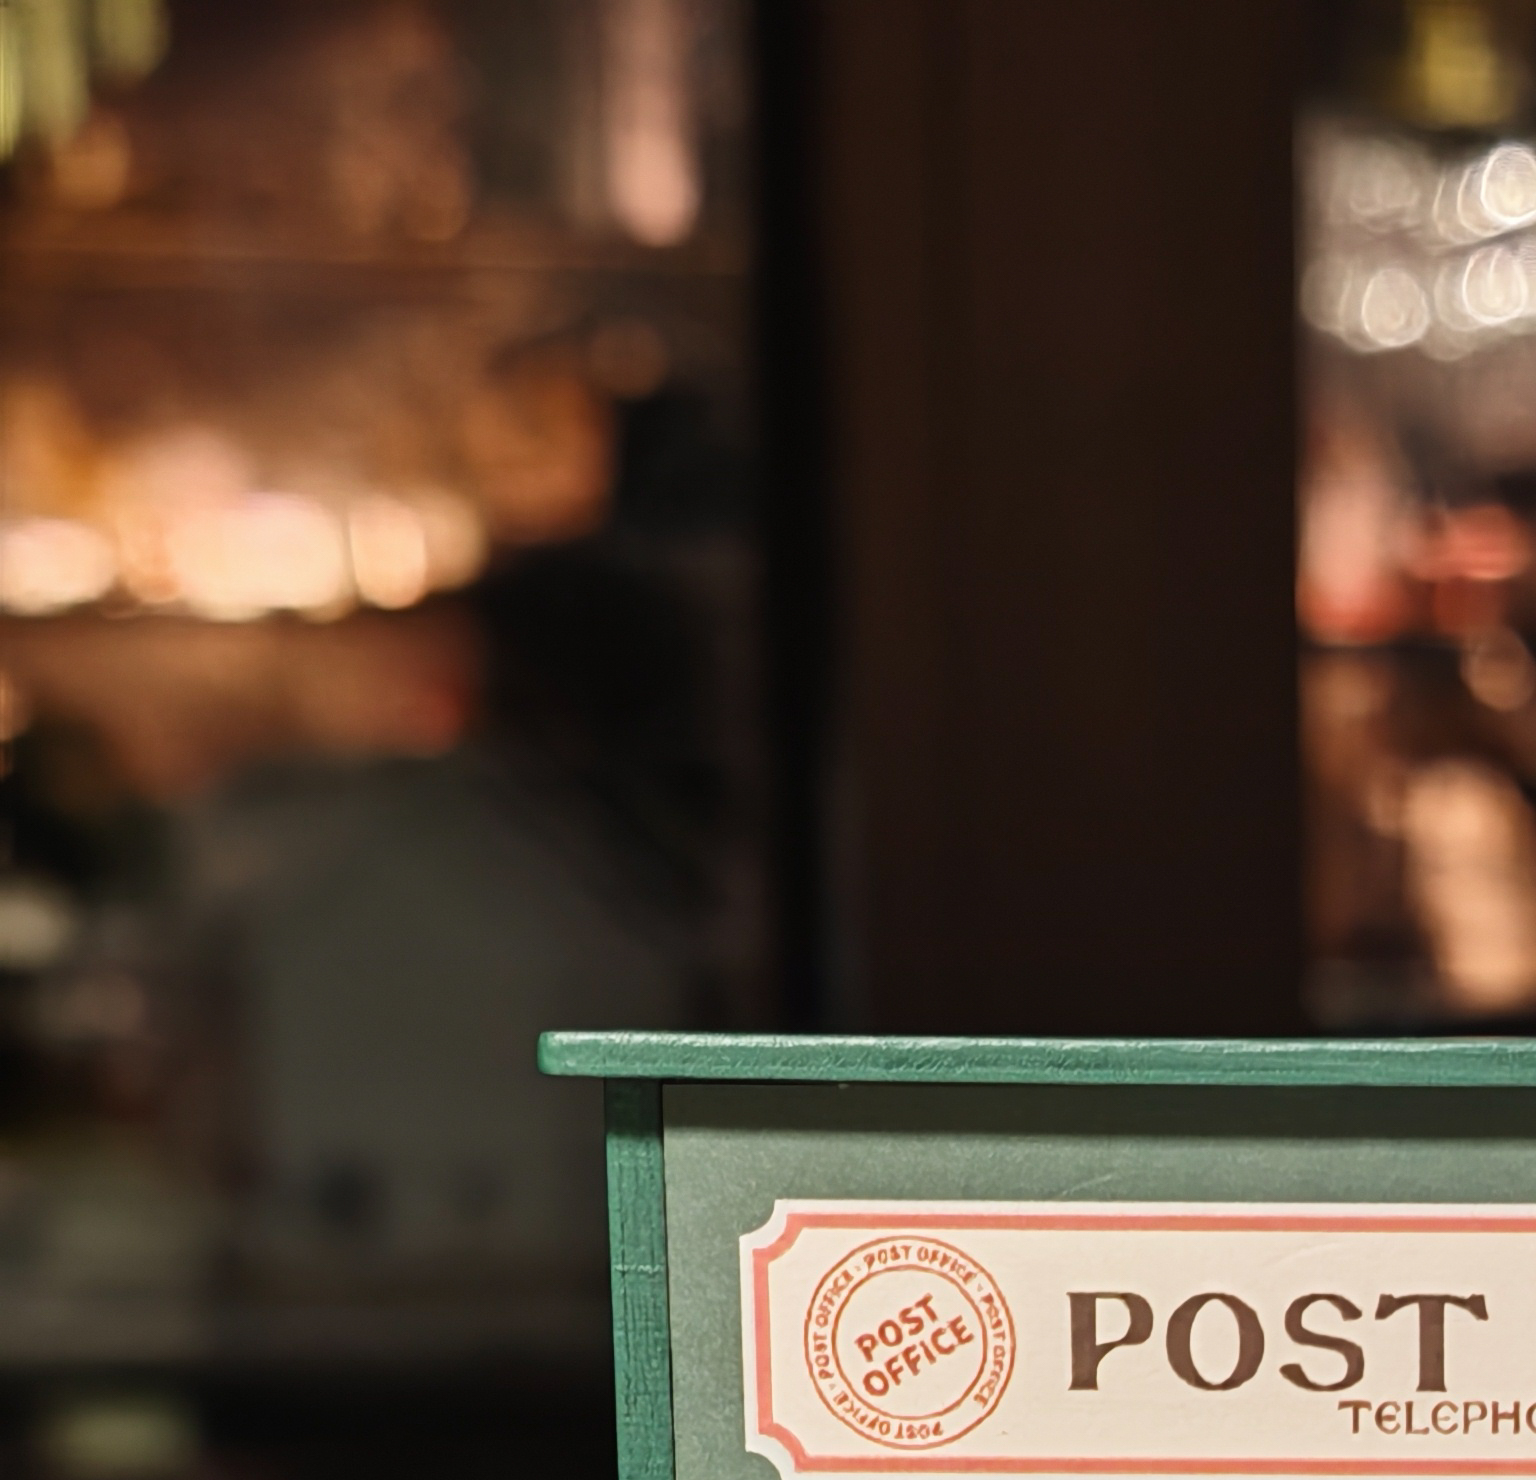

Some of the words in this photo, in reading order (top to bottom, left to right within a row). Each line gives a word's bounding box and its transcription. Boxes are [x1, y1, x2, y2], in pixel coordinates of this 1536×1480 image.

[854, 1292, 941, 1363] POST
[862, 1314, 975, 1397] OFFICE
[1066, 1291, 1489, 1392] POST
